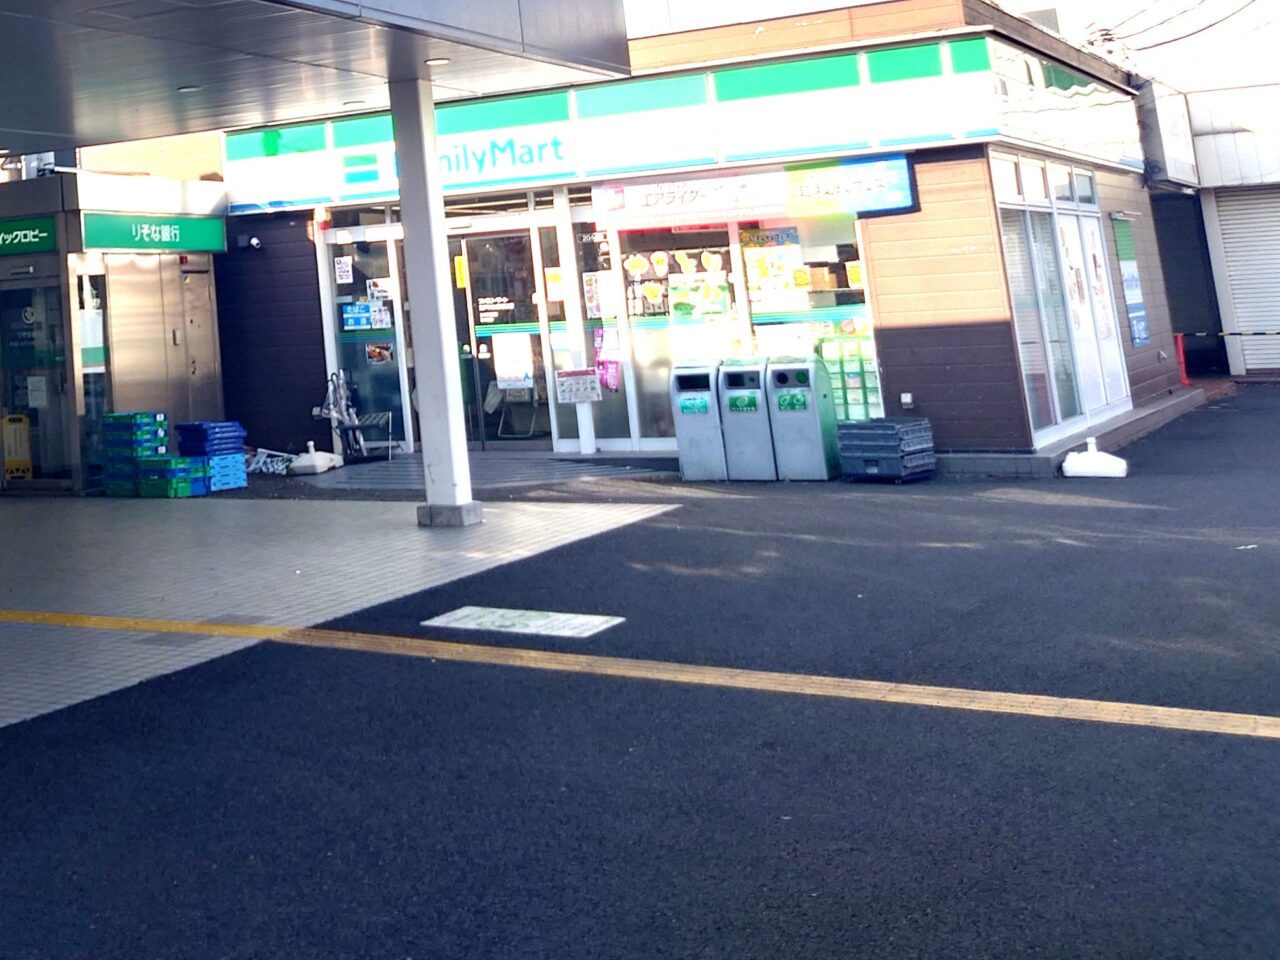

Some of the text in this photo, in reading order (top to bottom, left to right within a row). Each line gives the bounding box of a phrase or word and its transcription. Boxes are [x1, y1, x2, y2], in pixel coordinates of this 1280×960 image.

[132, 224, 180, 242] りそな銀行
